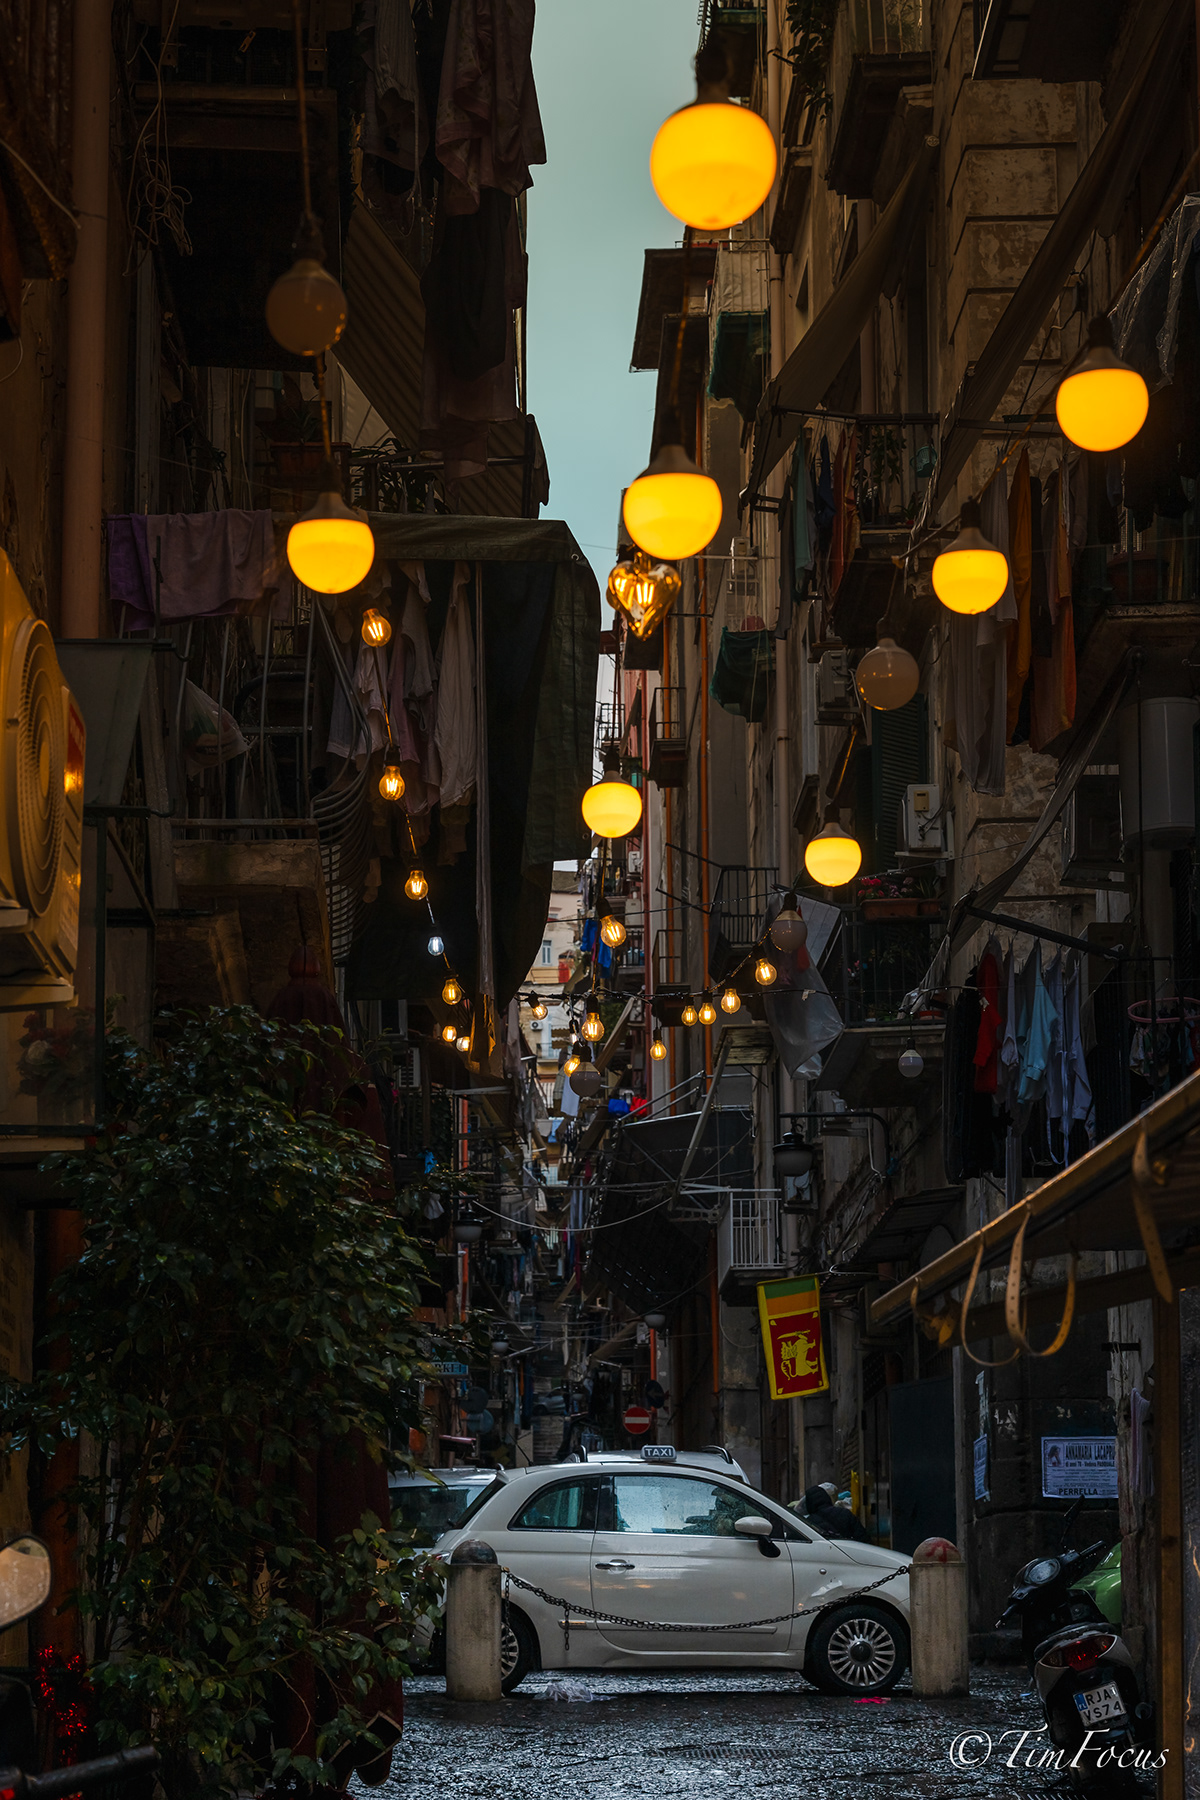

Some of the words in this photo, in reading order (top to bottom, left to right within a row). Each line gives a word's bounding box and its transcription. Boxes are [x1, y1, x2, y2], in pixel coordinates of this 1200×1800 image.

[645, 1448, 672, 1457] TAXI
[1059, 1488, 1098, 1496] PERRELLA
[1083, 1701, 1122, 1721] VS74
